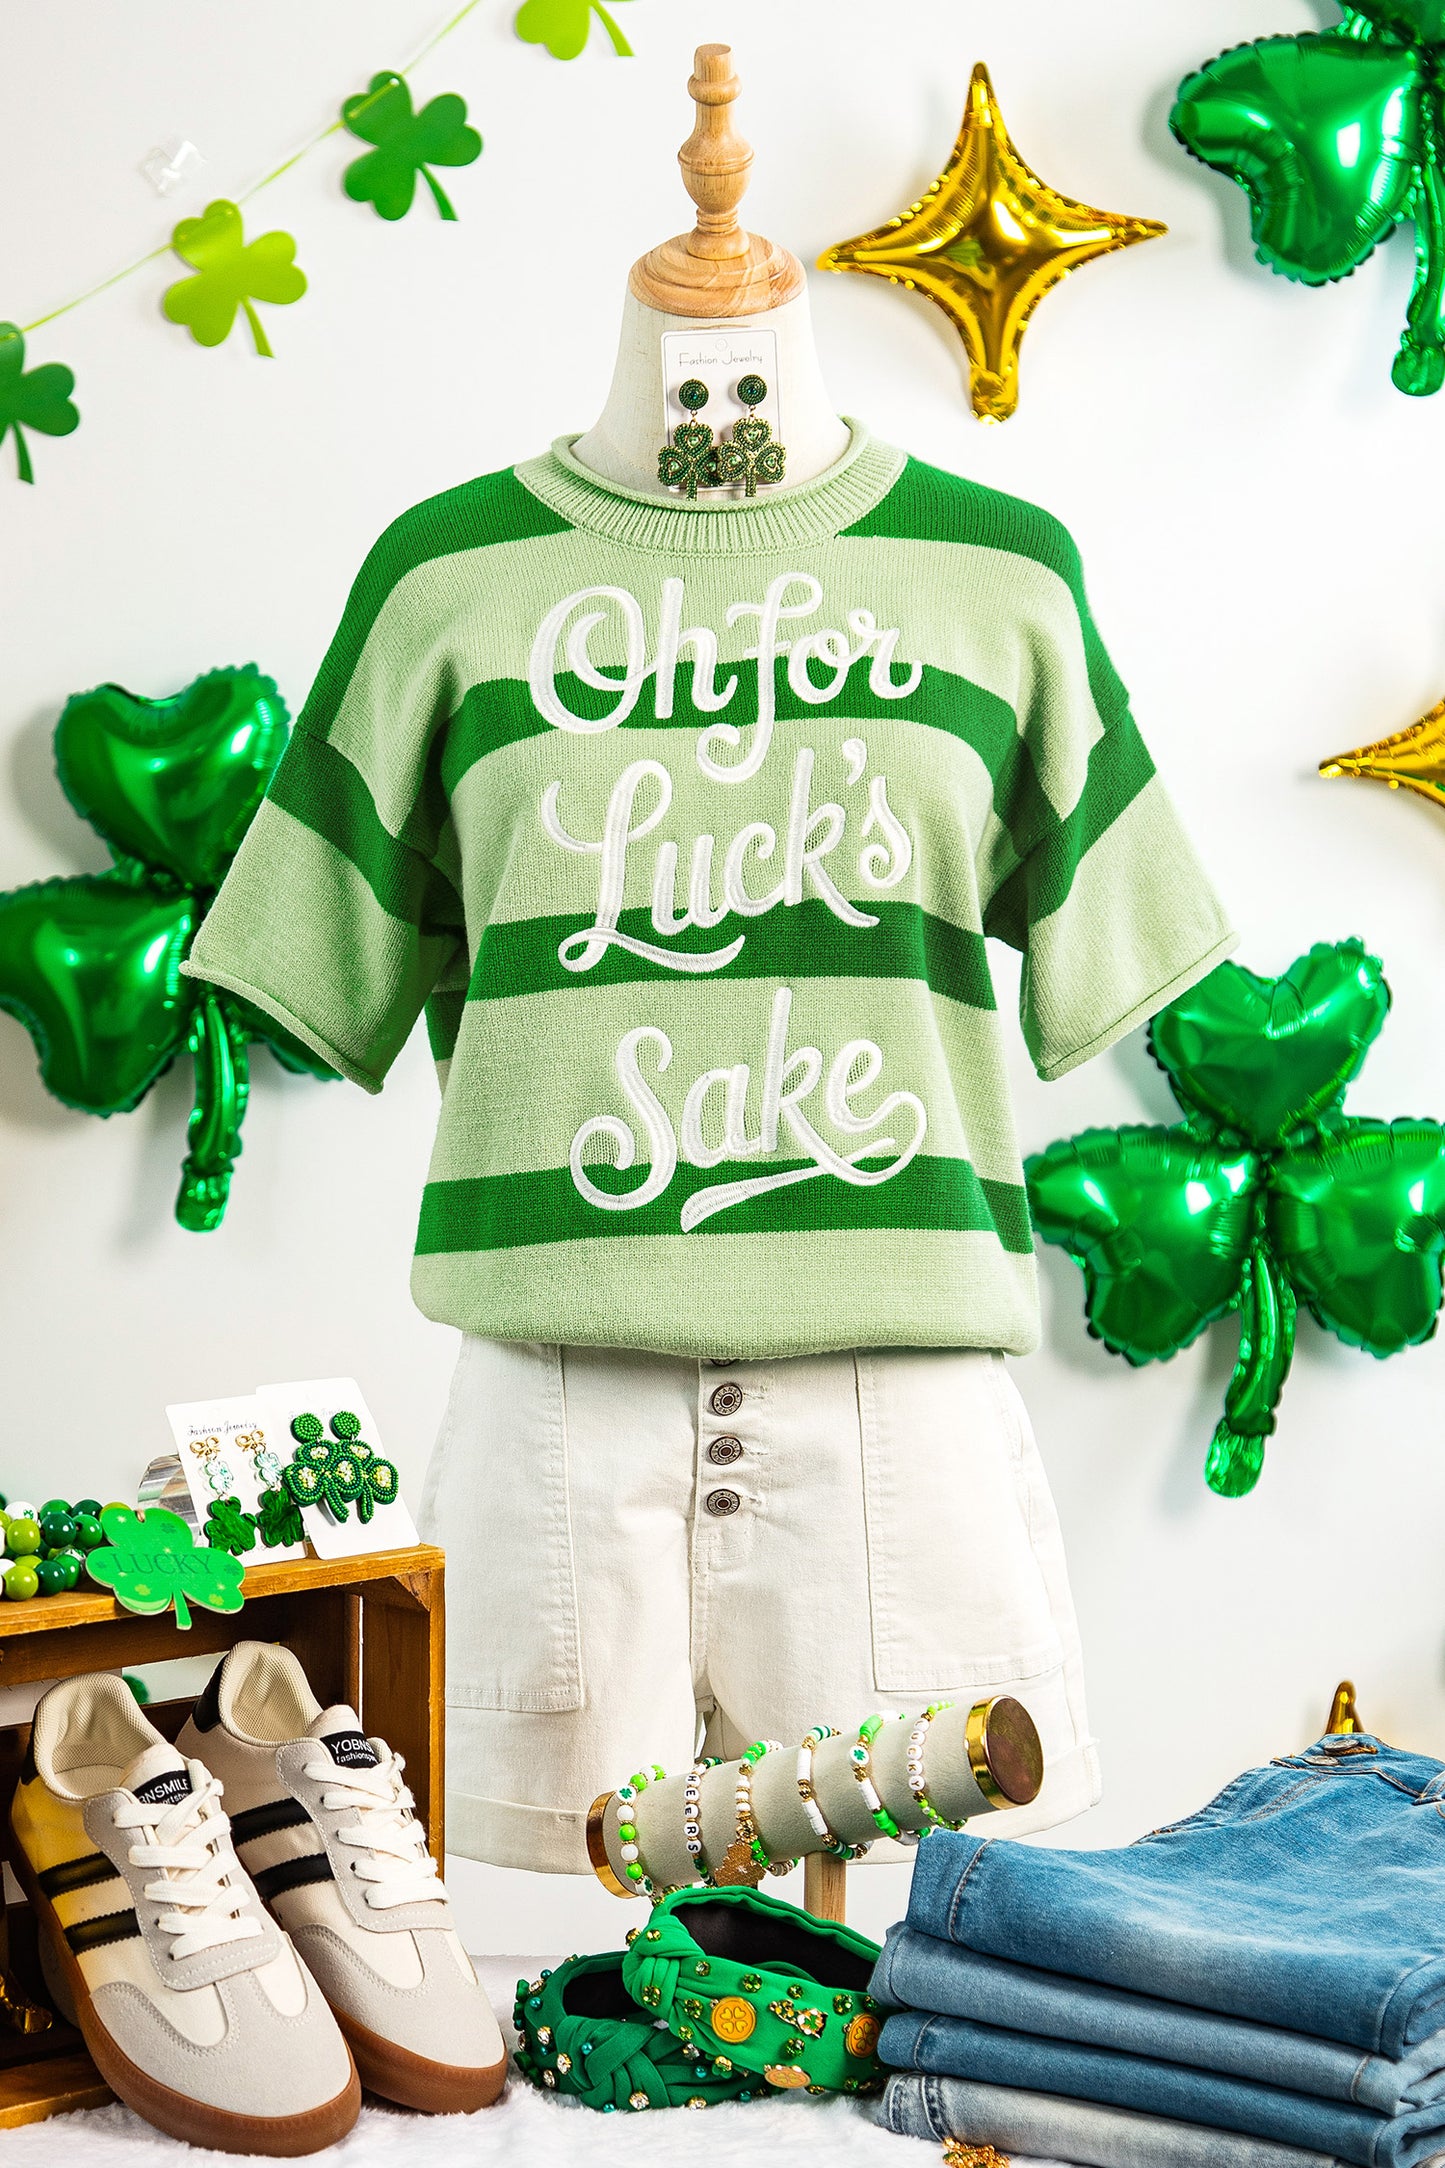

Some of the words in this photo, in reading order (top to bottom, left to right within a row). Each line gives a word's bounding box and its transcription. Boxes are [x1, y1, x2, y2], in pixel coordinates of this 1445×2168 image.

[679, 351, 718, 367] Fashion
[721, 348, 763, 366] Jewelry
[528, 576, 738, 734] Oh
[696, 571, 923, 783] for
[541, 739, 911, 973] Luck's
[569, 986, 926, 1232] Sake
[110, 1552, 213, 1575] LUCKY
[908, 1720, 925, 1787] LUCKY
[684, 1766, 699, 1852] HEERS
